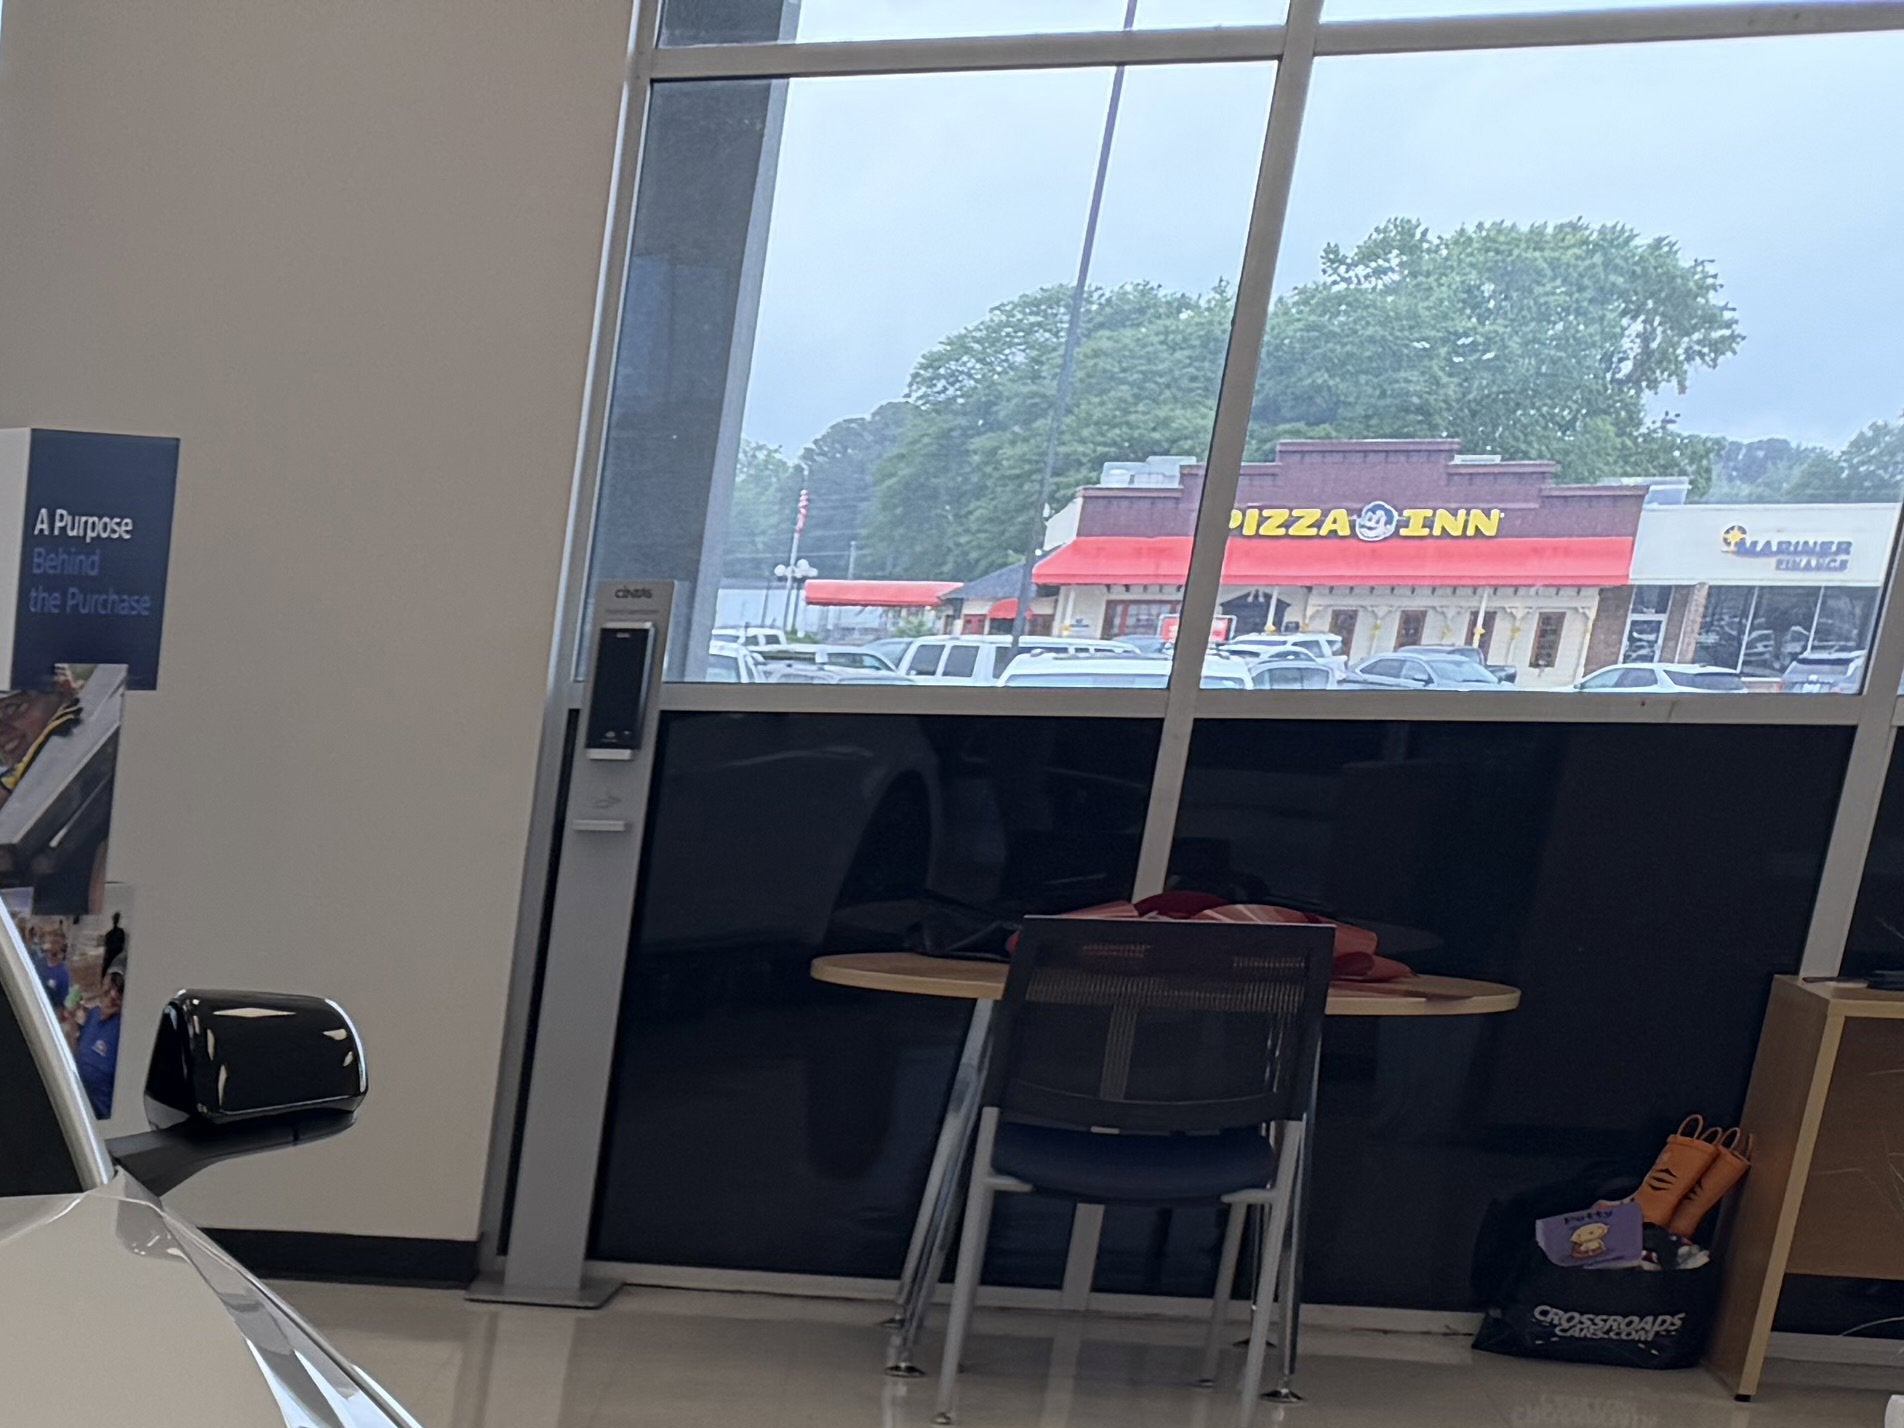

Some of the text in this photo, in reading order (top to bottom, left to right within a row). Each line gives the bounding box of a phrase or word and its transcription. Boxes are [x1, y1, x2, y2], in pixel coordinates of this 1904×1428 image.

[33, 507, 134, 543] A Purpose
[1399, 508, 1500, 537] INN
[31, 547, 100, 576] Behind
[1736, 540, 1853, 558] MARINER
[1775, 558, 1850, 572] FINANCE
[29, 585, 152, 616] the Purchase
[1533, 1304, 1686, 1332] CROSSROADS
